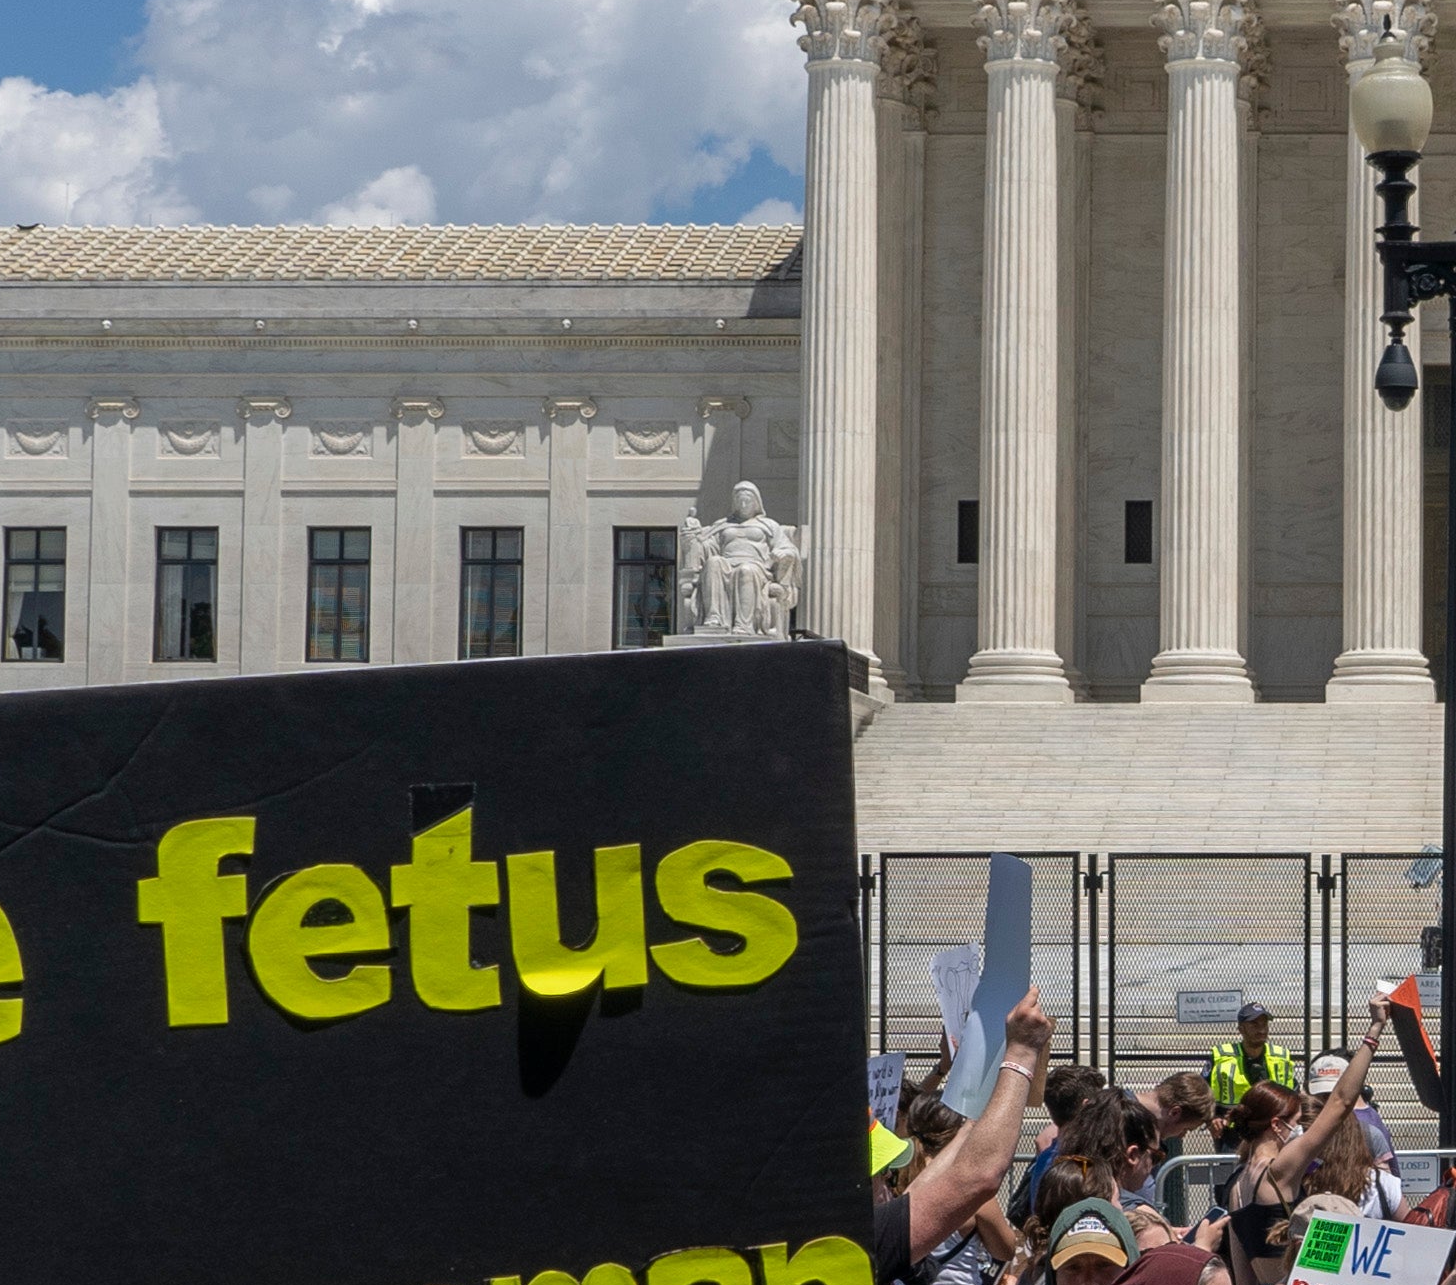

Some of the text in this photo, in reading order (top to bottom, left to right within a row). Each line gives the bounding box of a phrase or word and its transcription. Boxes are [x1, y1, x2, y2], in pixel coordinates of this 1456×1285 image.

[137, 810, 798, 1027] fetus
[1184, 995, 1237, 1004] AREA CLOSED
[1399, 1161, 1430, 1170] LOSED
[1352, 1223, 1406, 1279] WE
